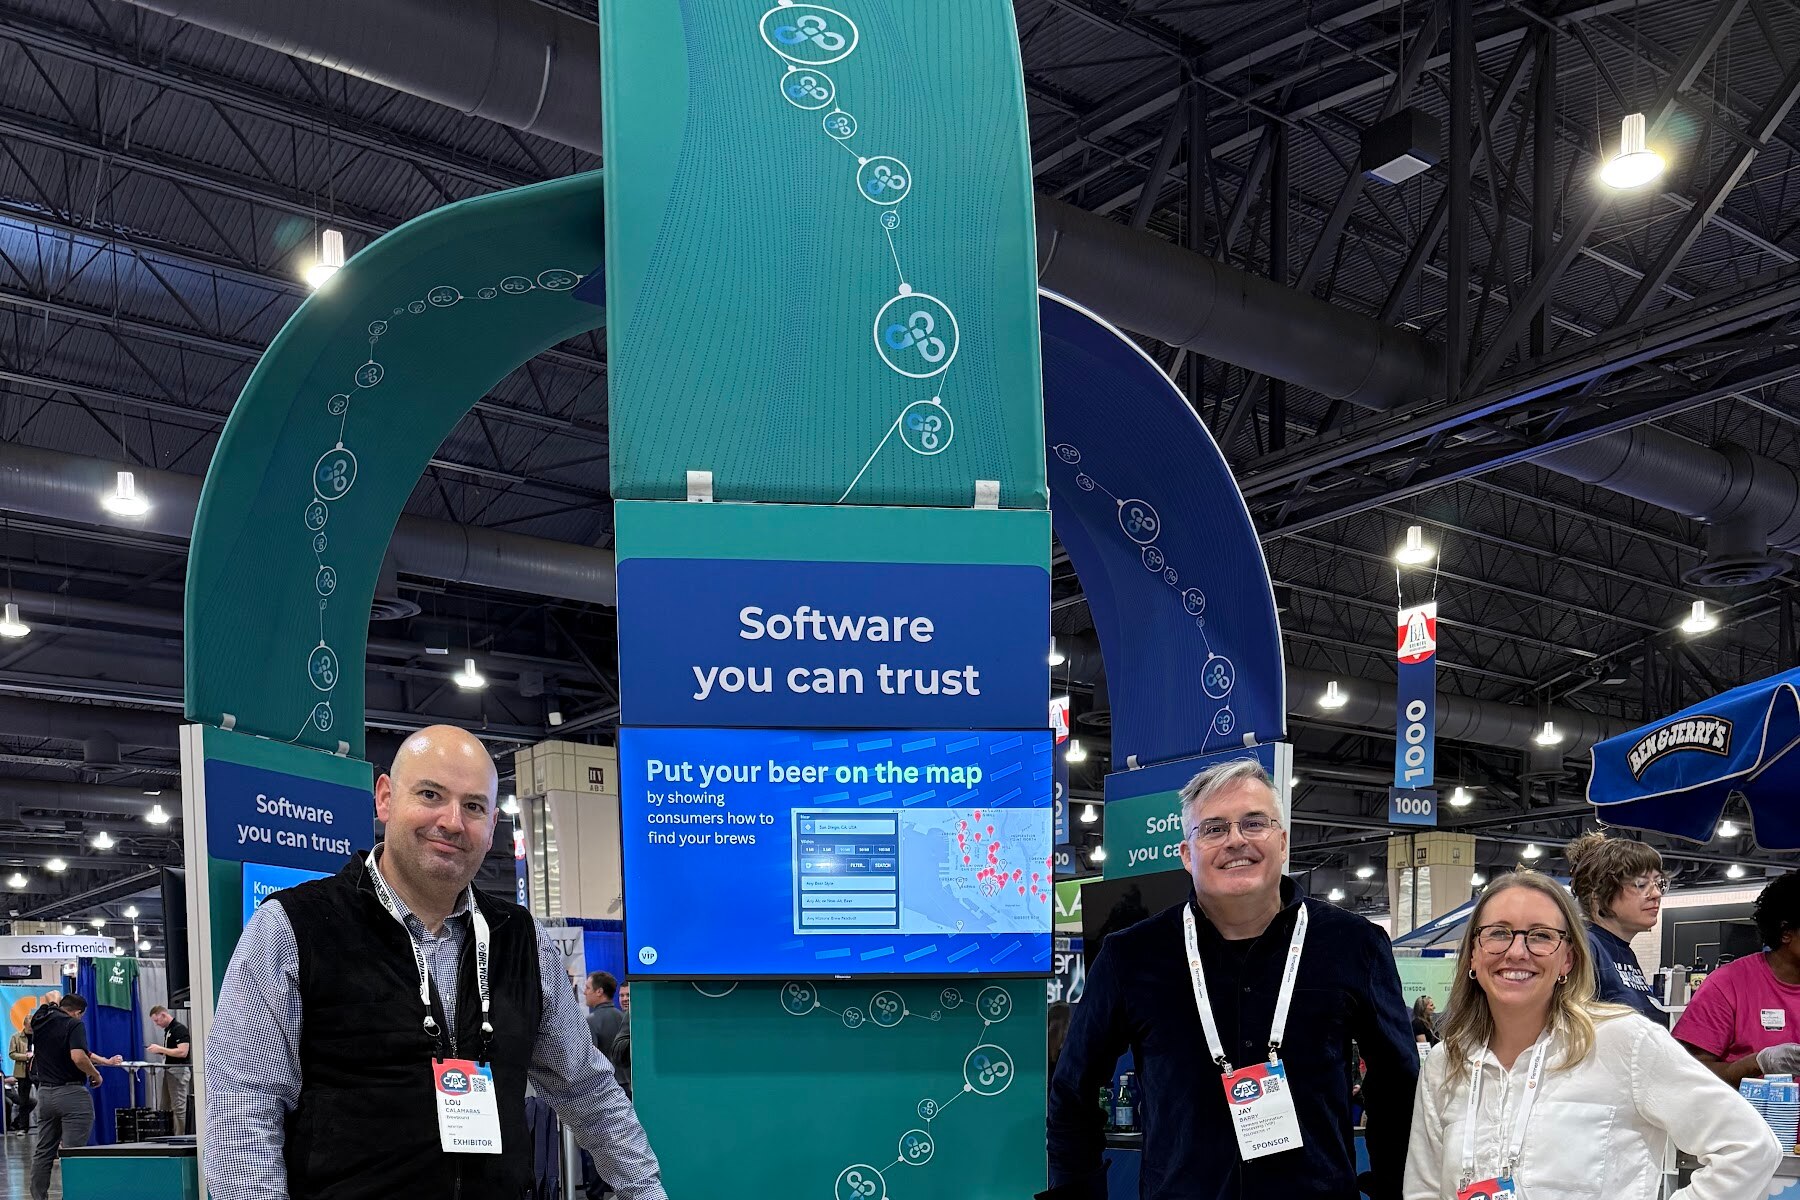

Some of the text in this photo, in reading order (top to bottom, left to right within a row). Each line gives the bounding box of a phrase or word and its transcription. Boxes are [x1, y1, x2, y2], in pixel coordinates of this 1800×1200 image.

[739, 605, 935, 643] Software
[692, 663, 981, 701] you can trust
[1405, 699, 1427, 782] 1000
[1630, 734, 1658, 774] BEN
[1668, 720, 1727, 751] JERRY'S
[647, 759, 983, 790] Put your beer on the map
[647, 791, 725, 807] by showing
[1395, 797, 1432, 816] 1000
[256, 793, 334, 825] Software
[647, 813, 774, 826] consumers how to
[1146, 812, 1183, 835] Soft
[237, 824, 352, 856] you can trust
[648, 832, 756, 849] find your brews
[1055, 852, 1069, 866] 00
[1128, 843, 1181, 868] you ca
[21, 941, 107, 954] dsm-firmenich
[444, 1098, 462, 1106] LOU
[1238, 1106, 1253, 1116] JAY
[453, 1138, 493, 1148] EXHIBITOR
[1252, 1136, 1291, 1152] SPONSOR
